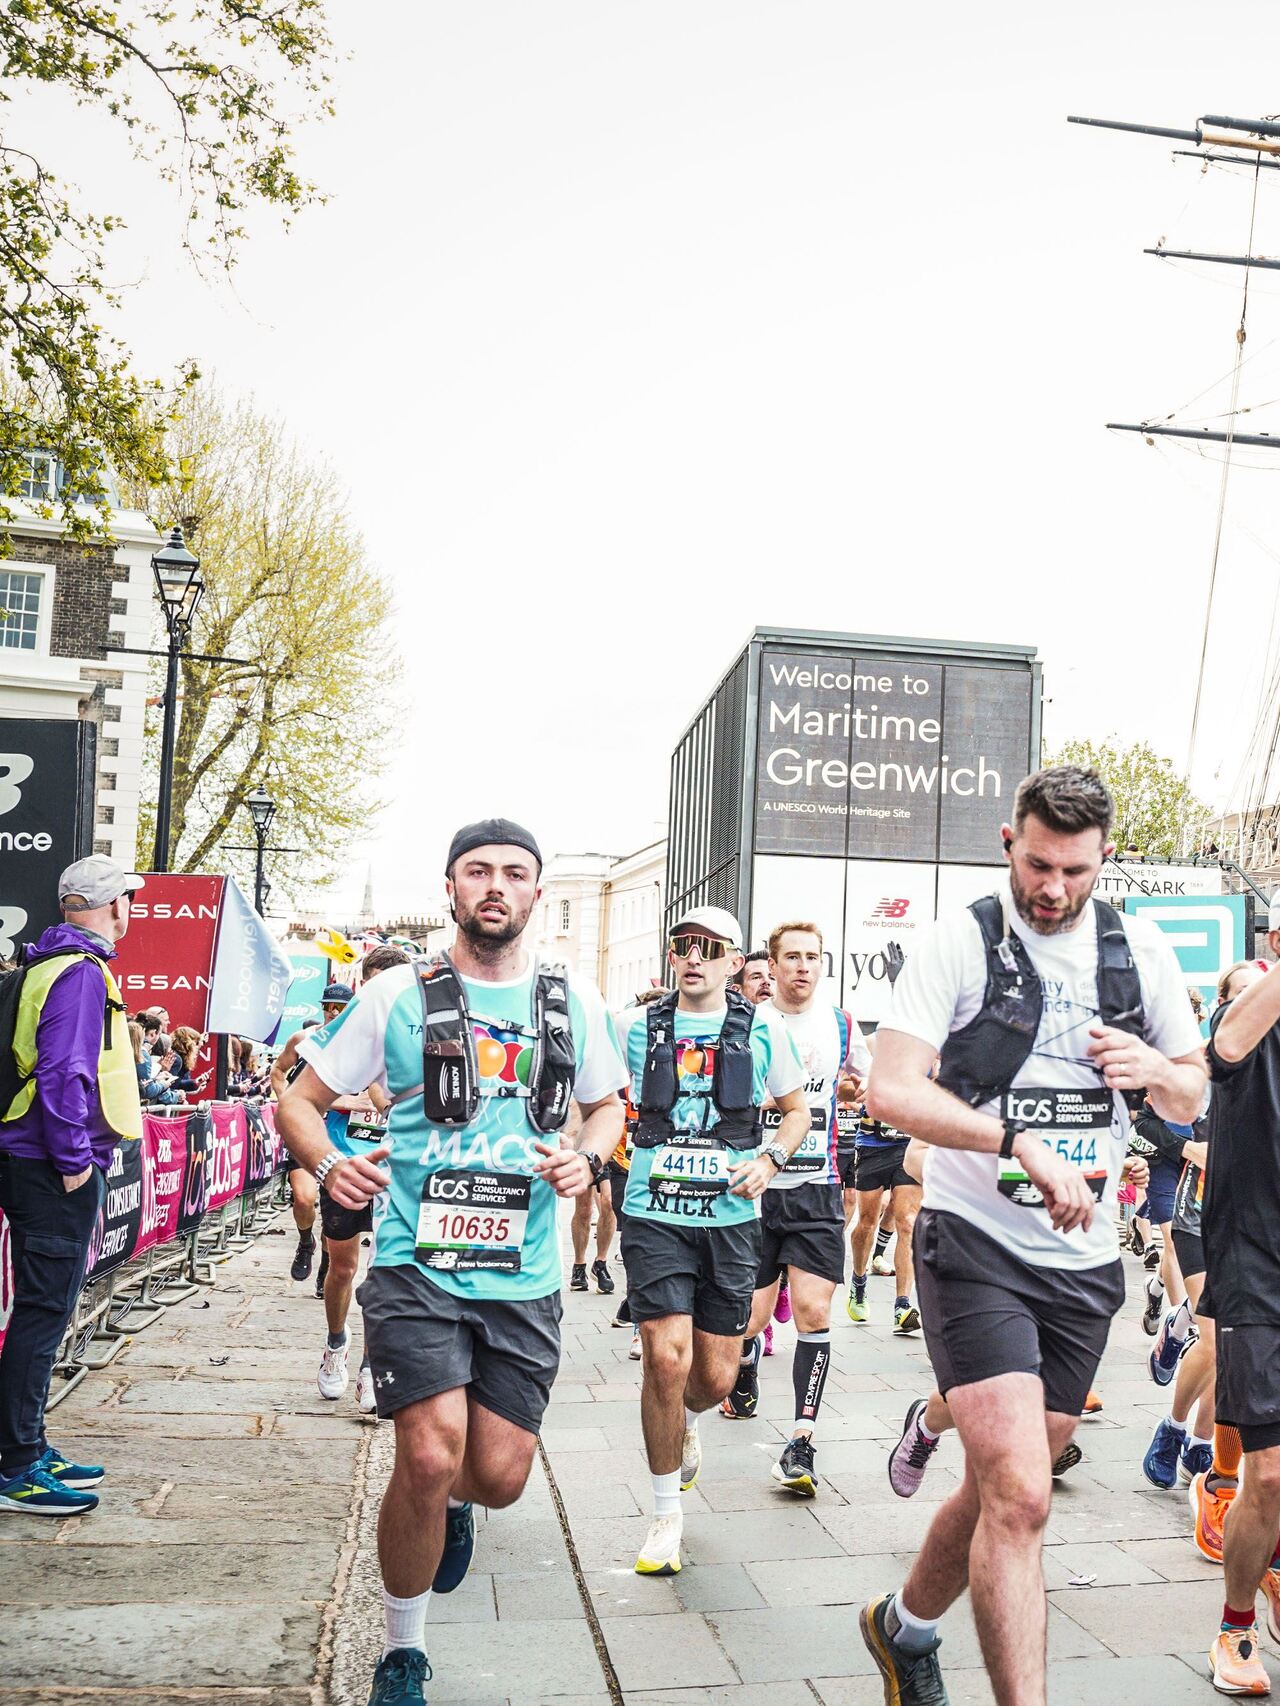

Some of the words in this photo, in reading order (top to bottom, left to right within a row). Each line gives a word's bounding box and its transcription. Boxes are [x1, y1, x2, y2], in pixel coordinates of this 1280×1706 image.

[769, 664, 893, 693] Welcome
[902, 674, 929, 695] to
[769, 700, 941, 743] Maritime
[766, 748, 1001, 798] Greenwich
[763, 802, 772, 811] A
[773, 803, 816, 813] UNESCO
[818, 804, 848, 815] World
[850, 807, 891, 819] Heritage
[892, 808, 911, 819] Site
[1104, 867, 1146, 877] WELCOME
[1147, 869, 1159, 877] TO
[1140, 880, 1186, 895] SARK
[130, 903, 218, 920] SSAN
[881, 920, 916, 929] balance
[117, 974, 213, 991] ISSAN
[803, 1078, 825, 1093] vid
[1056, 1094, 1083, 1103] TATA
[1007, 1094, 1052, 1123] tcs
[1056, 1103, 1109, 1113] CONSULTANCY
[765, 1111, 784, 1126] tc
[1056, 1113, 1093, 1123] SERVICES
[418, 1130, 547, 1173] MACS
[663, 1154, 718, 1175] 44115
[429, 1174, 469, 1200] tcs
[474, 1176, 498, 1185] TATA
[472, 1185, 526, 1196] CONSULTANCY
[472, 1193, 506, 1203] SERVICES
[646, 1191, 717, 1218] NICK
[438, 1214, 510, 1242] 10635
